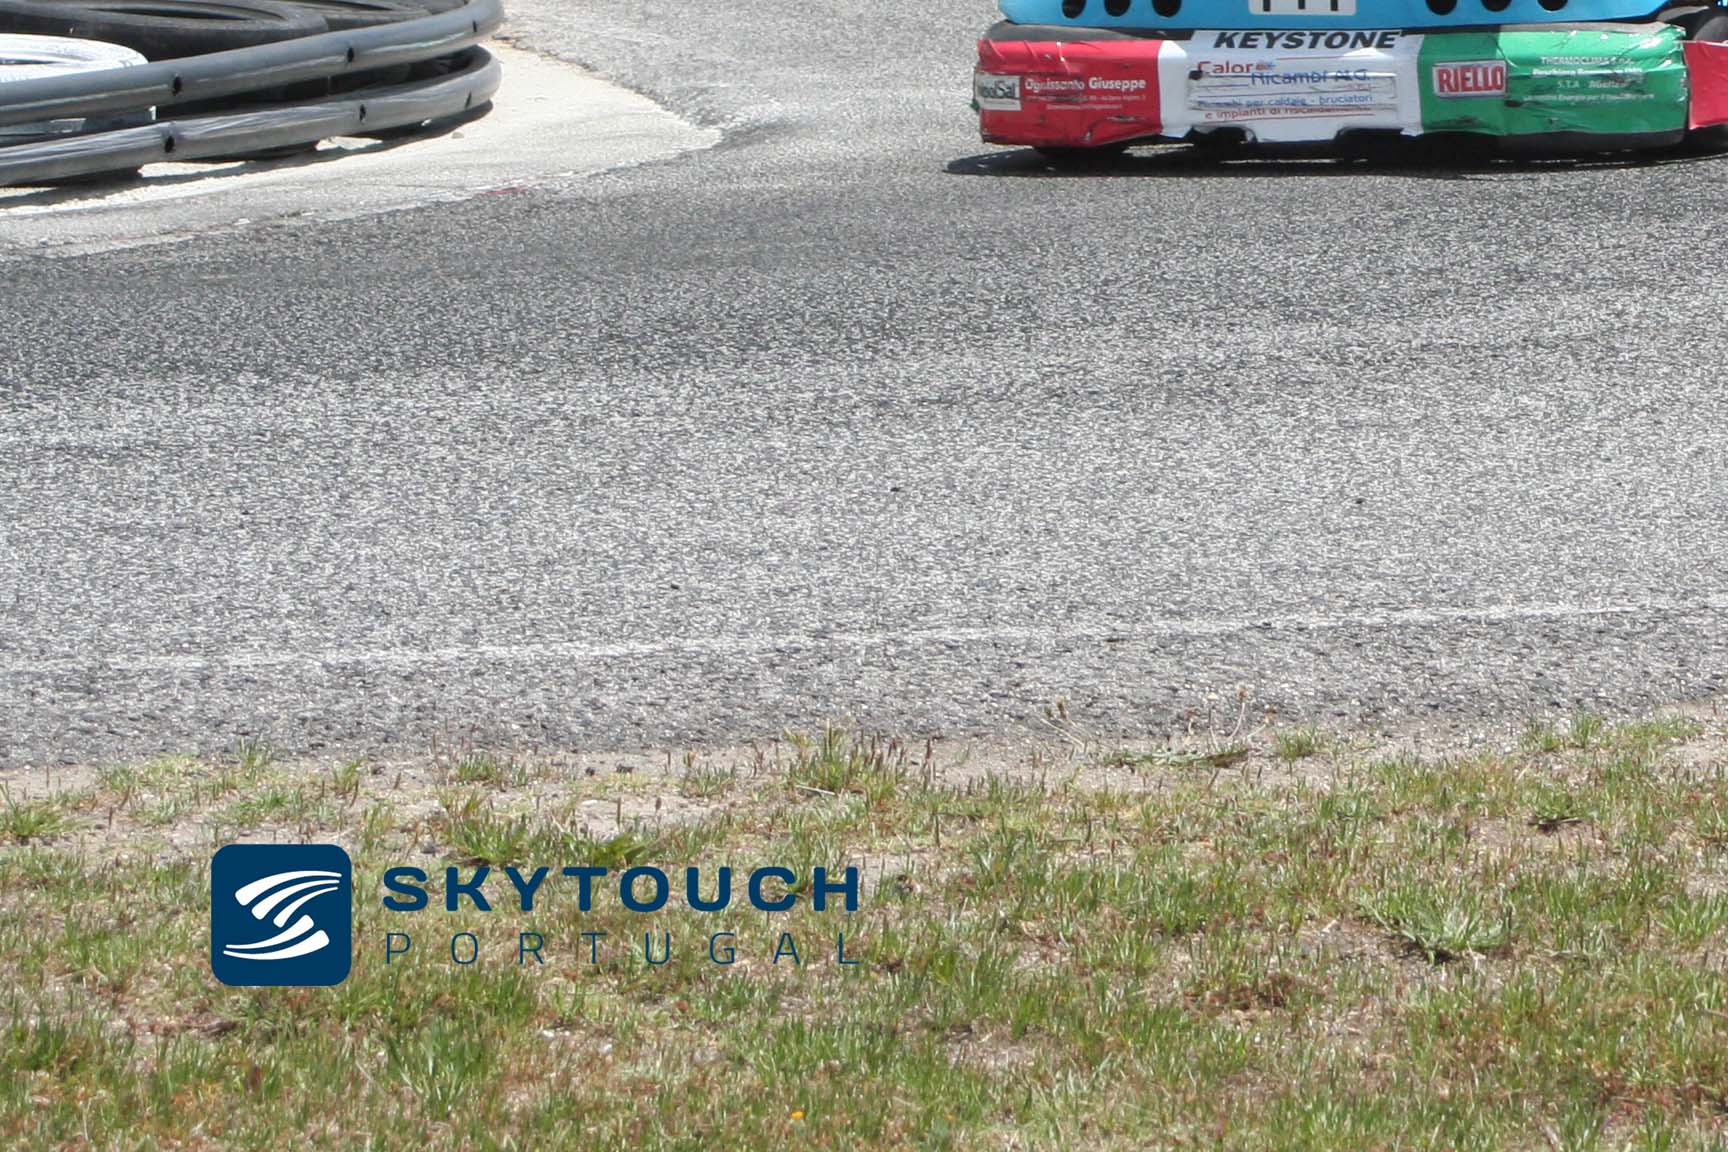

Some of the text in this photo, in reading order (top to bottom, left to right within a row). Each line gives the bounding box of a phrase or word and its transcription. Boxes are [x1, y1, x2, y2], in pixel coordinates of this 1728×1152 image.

[1214, 31, 1400, 49] KEYSTONE
[1089, 77, 1146, 91] Giuseppe
[1438, 65, 1504, 93] RIELLO
